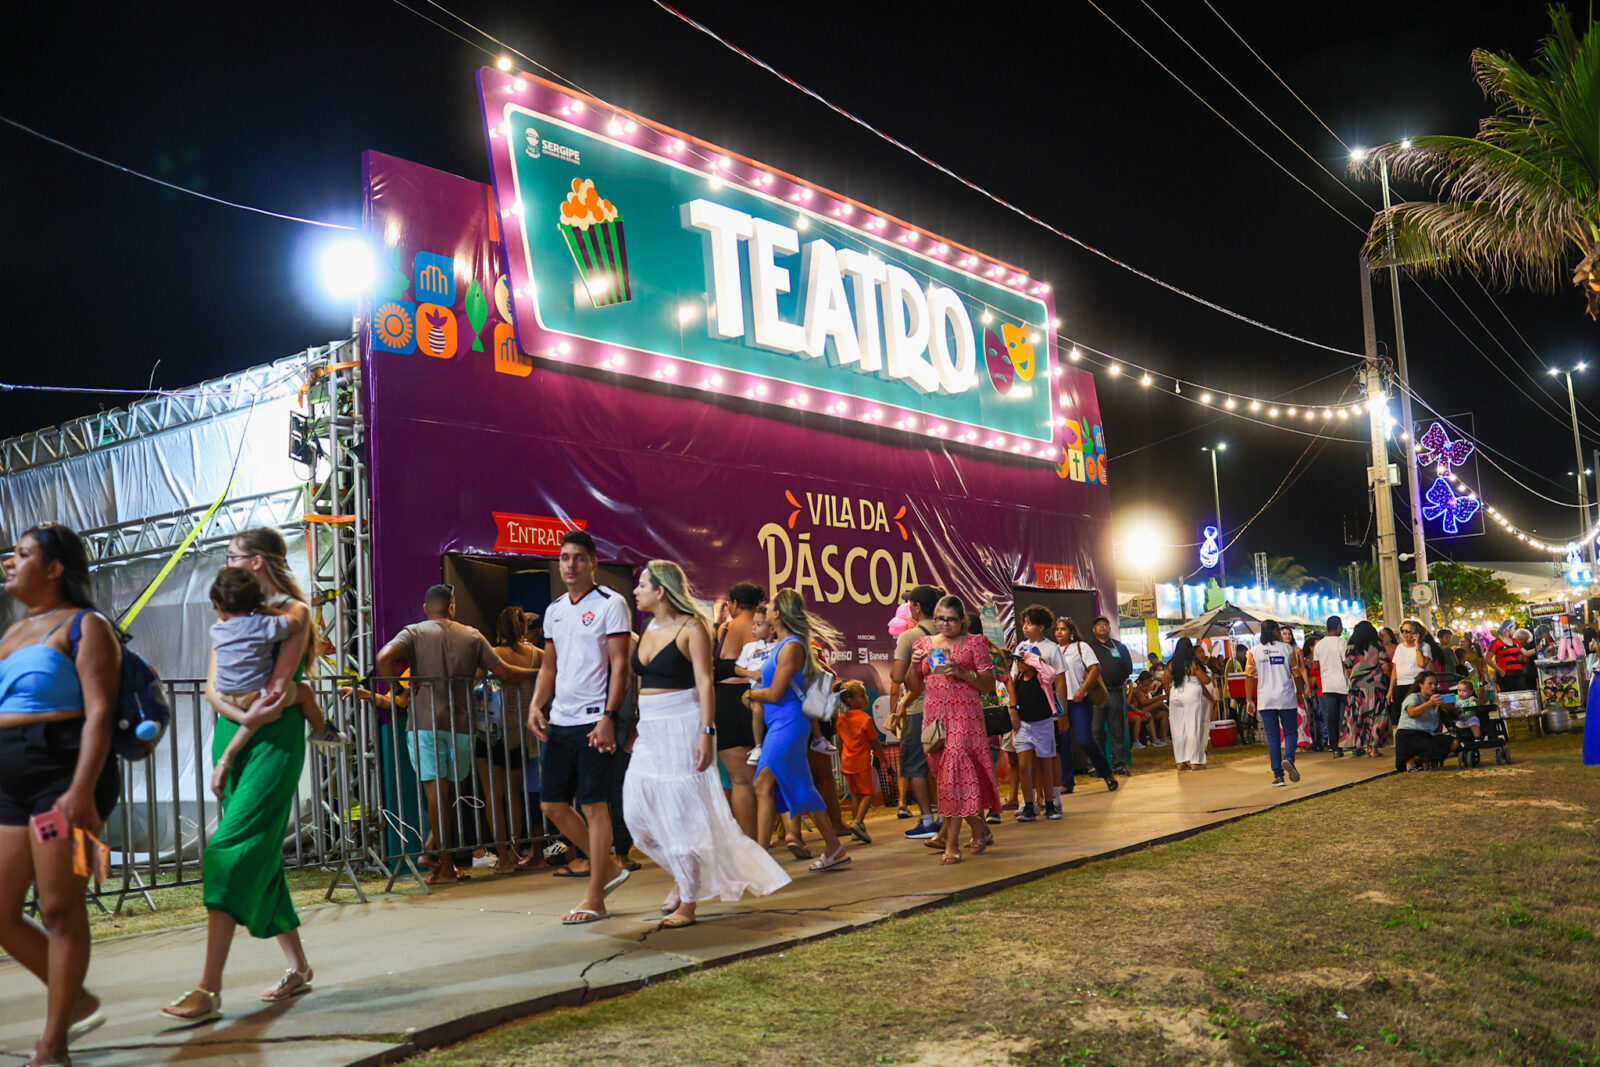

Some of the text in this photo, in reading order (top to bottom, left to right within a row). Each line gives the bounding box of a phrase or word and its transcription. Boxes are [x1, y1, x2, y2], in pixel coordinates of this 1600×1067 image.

[541, 139, 581, 161] SERGIPE
[679, 198, 978, 394] TEATRO
[806, 492, 890, 533] VILA DA
[506, 521, 566, 546] ENTRAD
[868, 651, 889, 661] Banese
